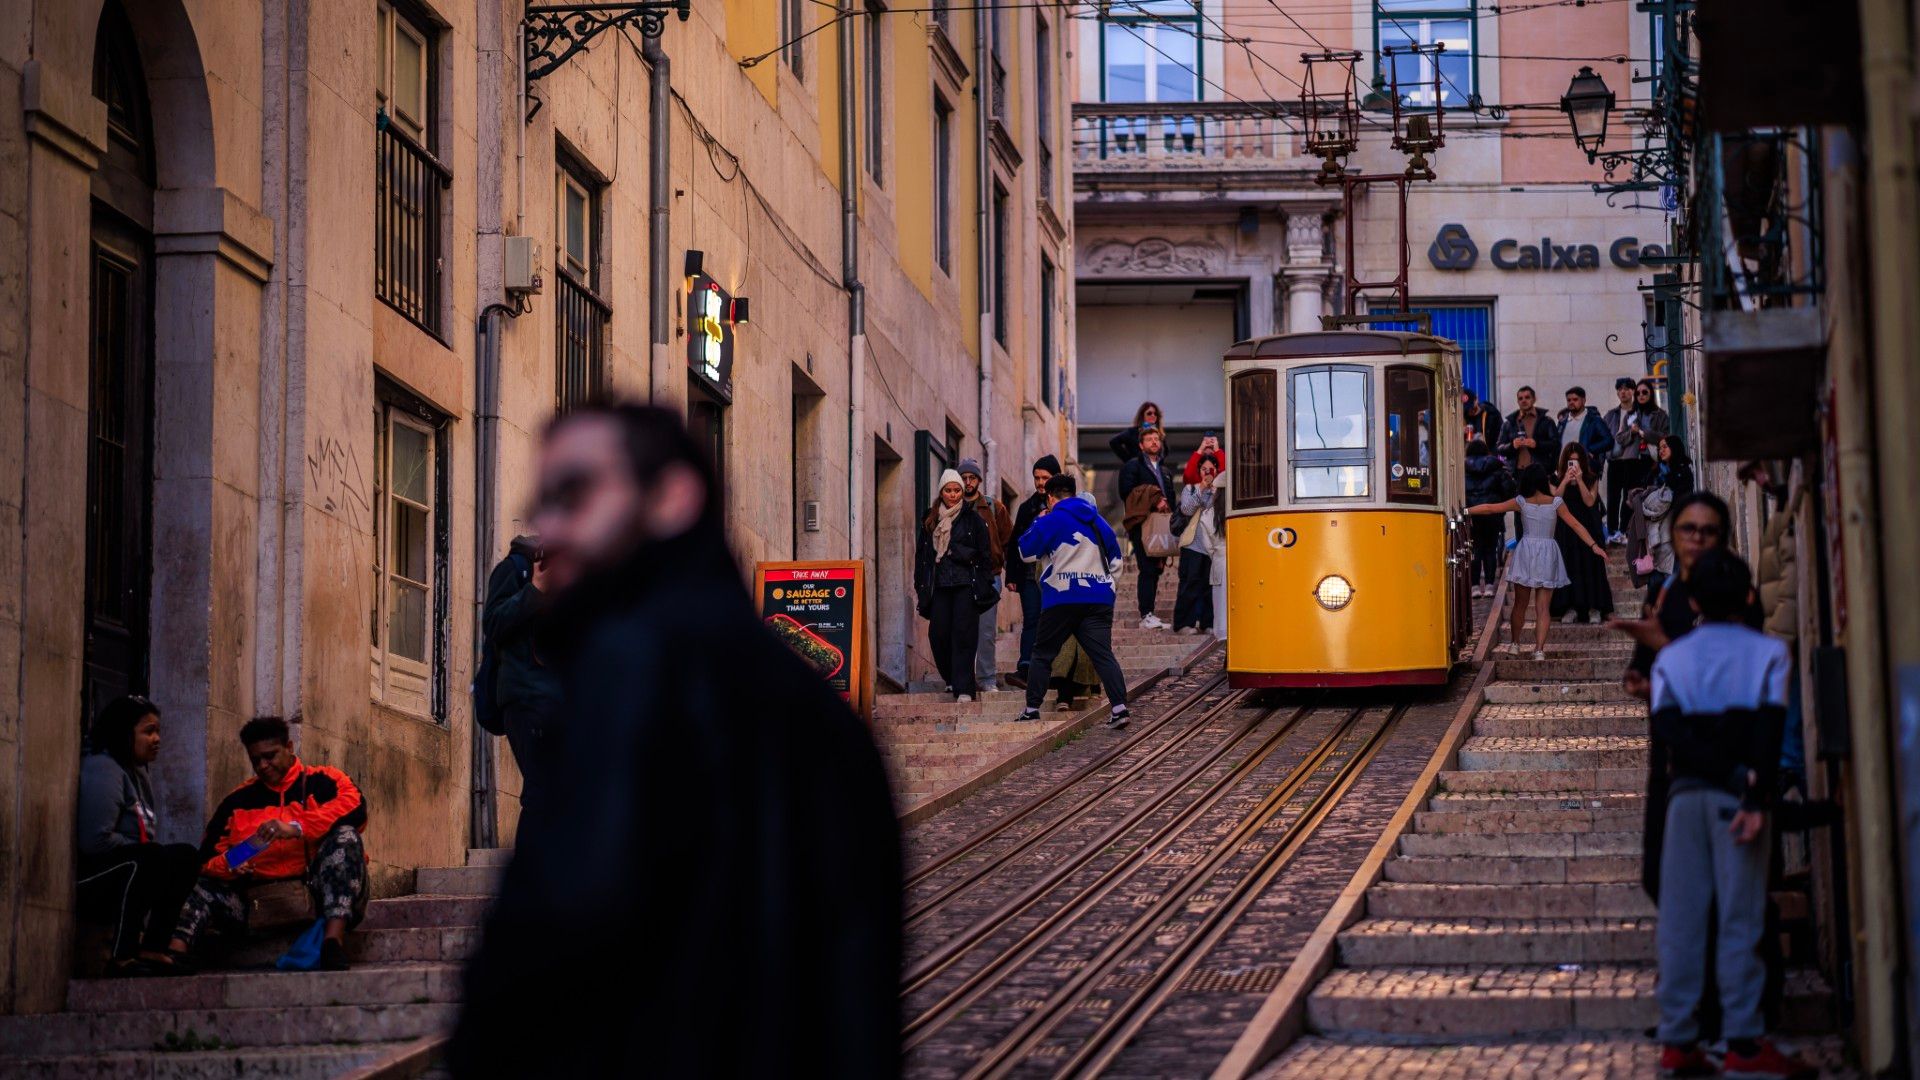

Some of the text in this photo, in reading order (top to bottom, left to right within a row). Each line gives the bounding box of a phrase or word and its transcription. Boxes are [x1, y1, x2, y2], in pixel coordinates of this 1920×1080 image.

[1490, 237, 1599, 270] Caixa
[1406, 466, 1430, 476] WI-FI
[1381, 525, 1386, 536] 1
[792, 570, 829, 579] TAKE AWAY
[786, 589, 830, 598] SAUSAGE
